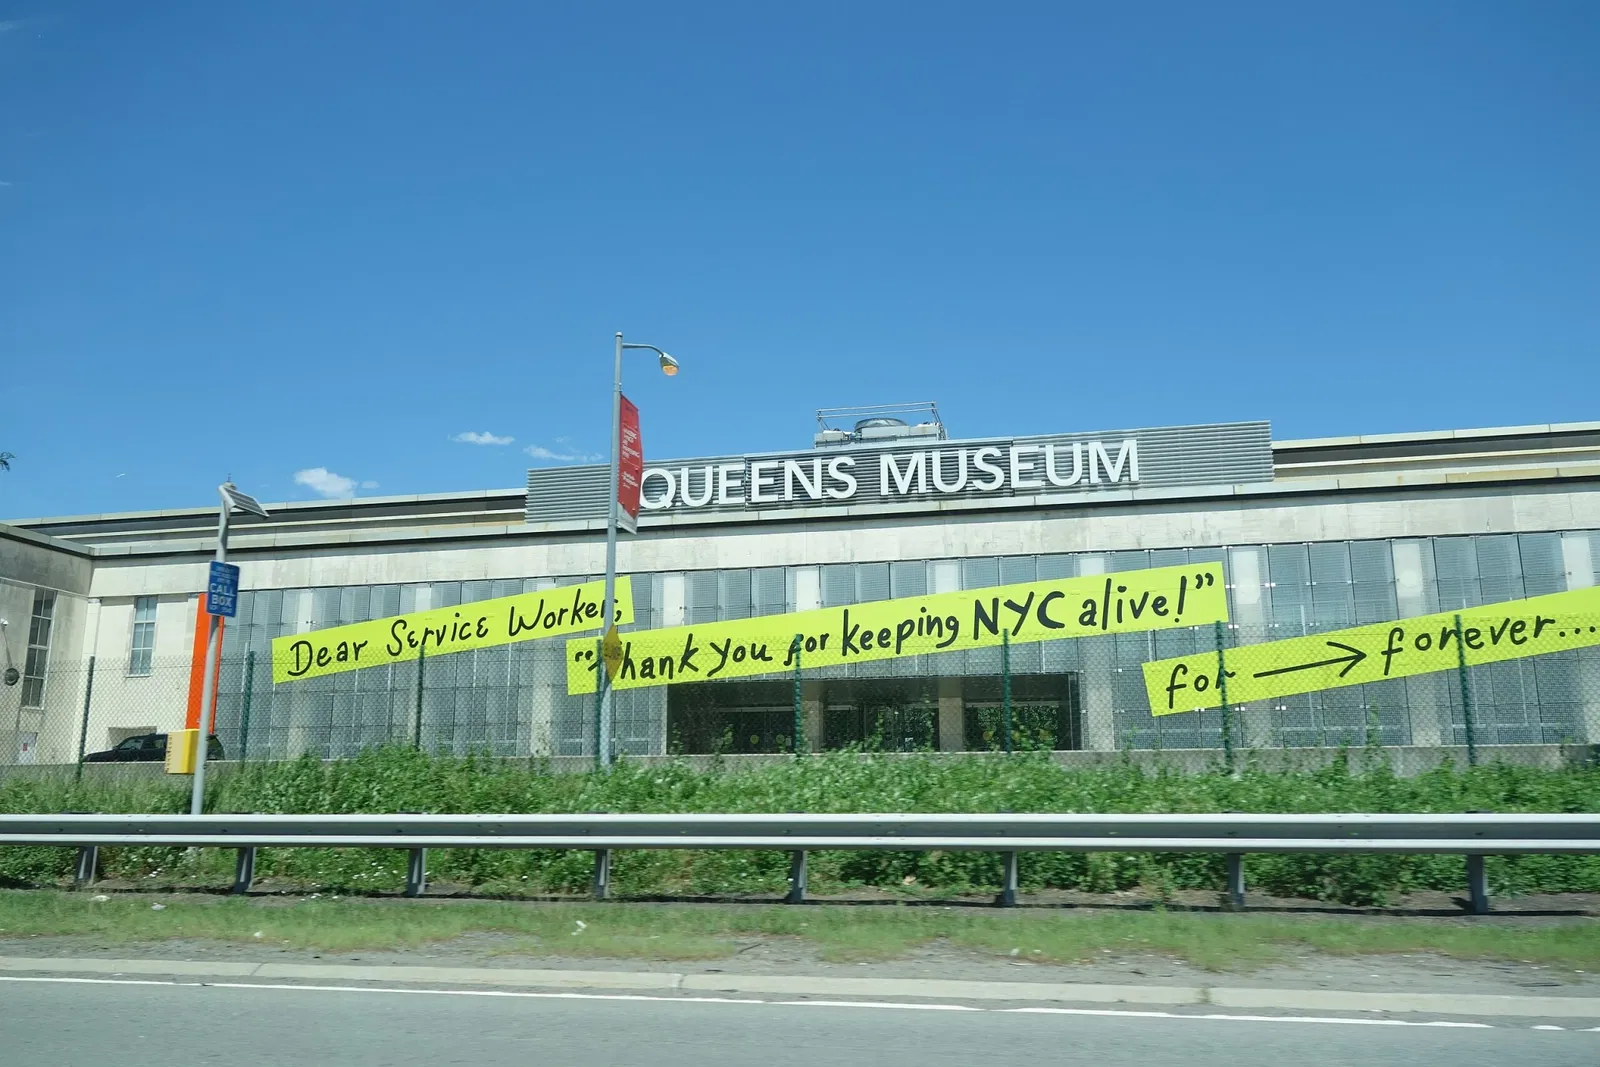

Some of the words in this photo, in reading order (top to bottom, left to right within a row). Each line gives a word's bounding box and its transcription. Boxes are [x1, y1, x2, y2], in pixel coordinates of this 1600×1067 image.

[639, 456, 858, 509] QUEENS
[879, 439, 1140, 496] MUSEUM
[209, 582, 236, 597] CALL
[211, 594, 233, 608] BOX
[287, 639, 368, 677] Dear
[386, 612, 489, 657] Service
[707, 638, 773, 678] you
[783, 632, 830, 667] for
[841, 606, 960, 656] keeping
[973, 590, 1065, 640] NYC
[1165, 663, 1237, 709] for
[1380, 615, 1597, 676] forever...
